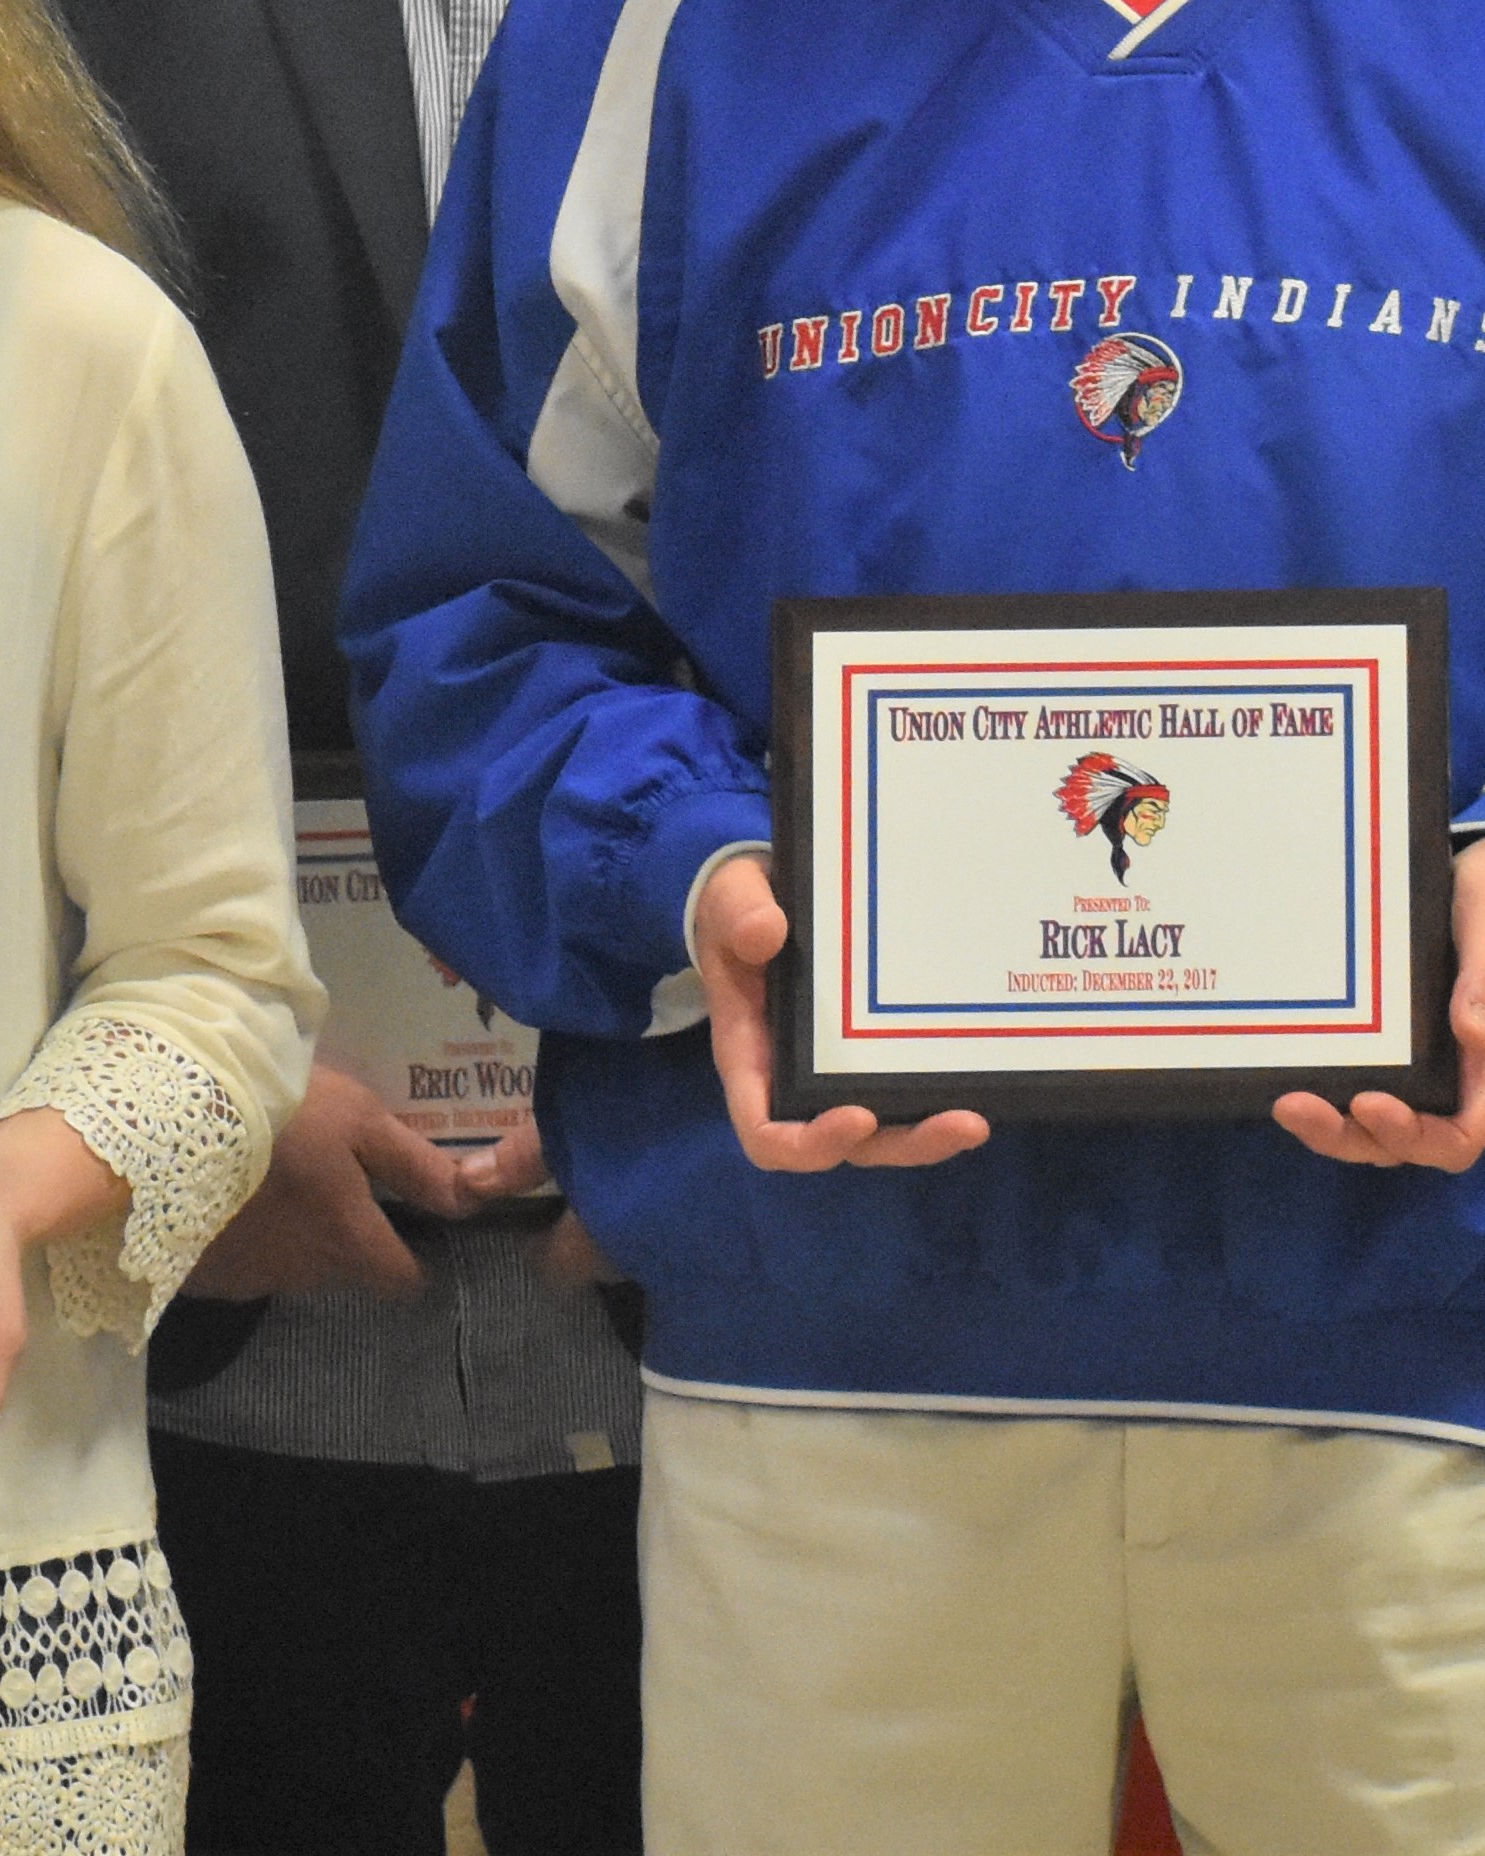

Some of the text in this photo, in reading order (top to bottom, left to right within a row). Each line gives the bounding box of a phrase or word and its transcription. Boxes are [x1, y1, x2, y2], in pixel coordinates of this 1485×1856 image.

[757, 293, 952, 380] UNION
[966, 275, 1138, 335] CITY
[889, 702, 1334, 743] UNION CITY ATHLETIC HALL OF FAME
[297, 870, 382, 904] ION CIT
[1073, 895, 1130, 913] PRESENTED
[1039, 920, 1185, 960] RICK LACY
[1006, 969, 1217, 995] INDUCTED: DECEMBER 22, 2017
[408, 1061, 534, 1100] ERIC WOO
